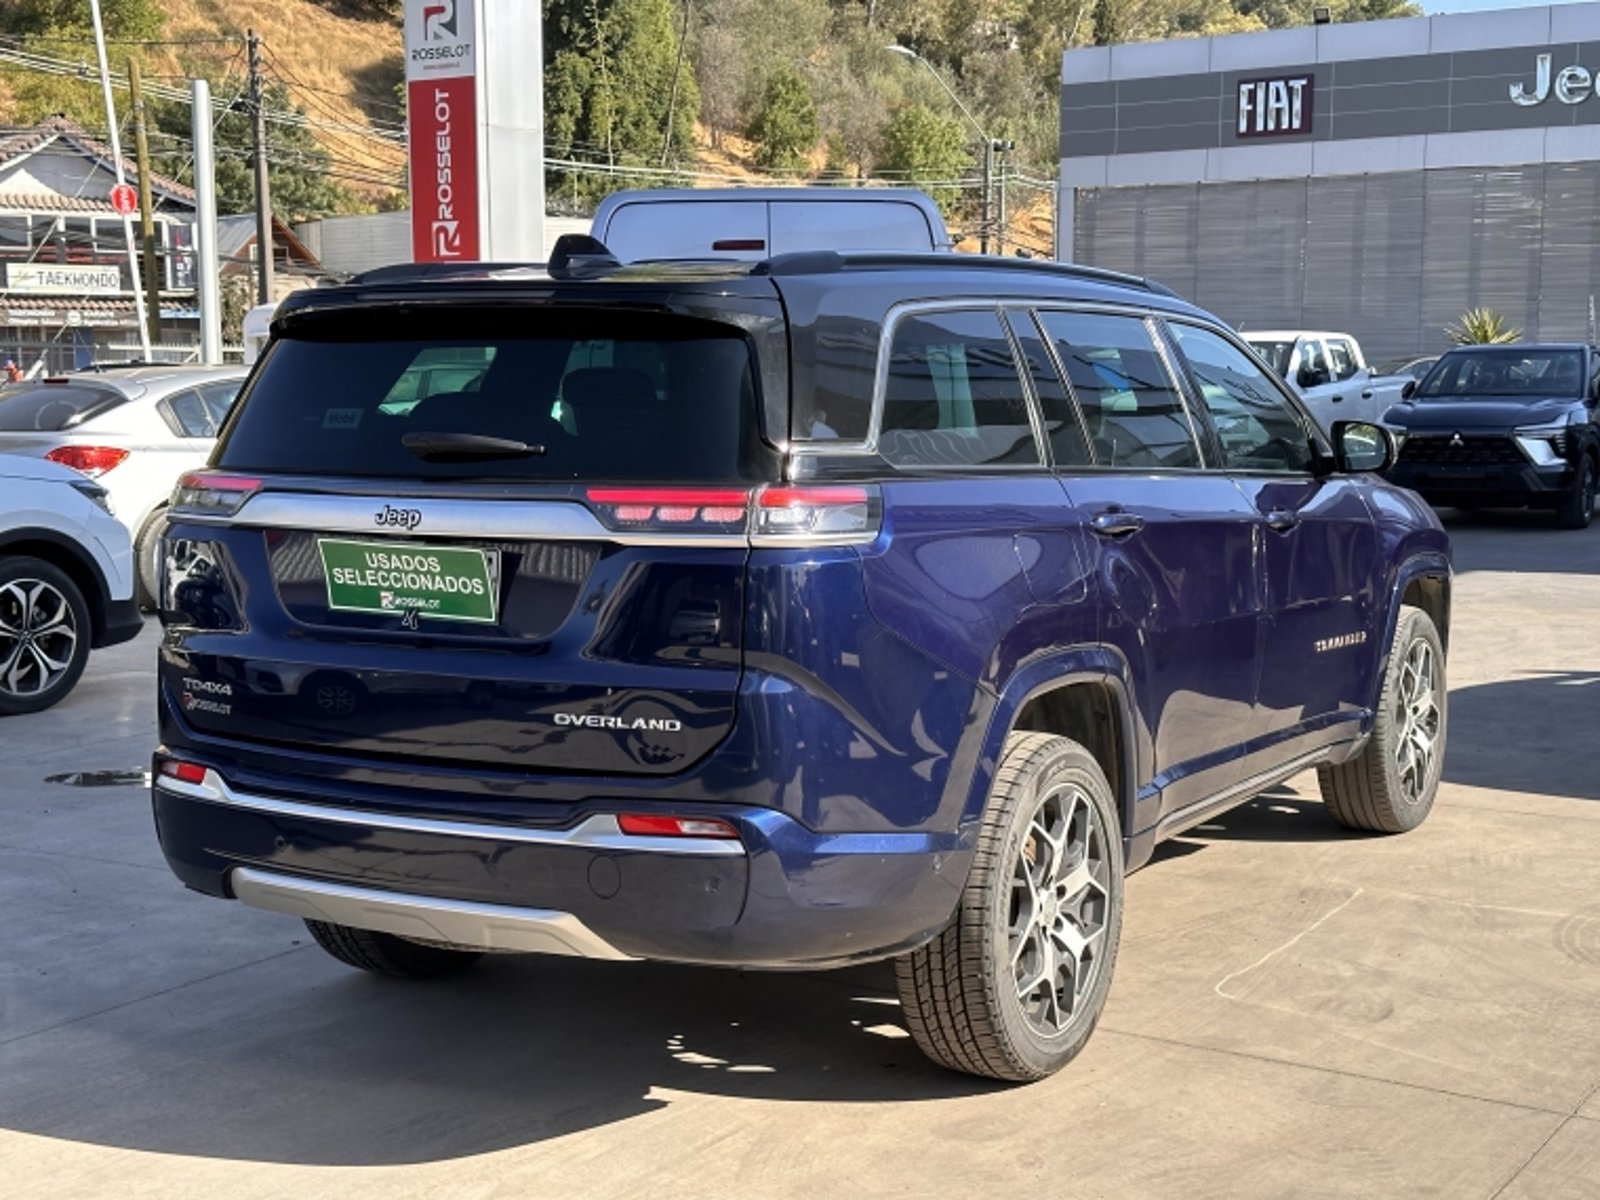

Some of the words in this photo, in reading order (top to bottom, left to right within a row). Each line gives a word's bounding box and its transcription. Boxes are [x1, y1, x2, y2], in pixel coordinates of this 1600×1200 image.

[412, 44, 471, 60] ROSSELOT
[1508, 53, 1600, 106] Je
[1238, 78, 1308, 133] FIAT
[435, 88, 453, 219] ROSSELOT
[37, 271, 119, 287] TAEKWONDO
[375, 505, 422, 530] Jeep
[365, 552, 441, 573] USADOS
[332, 567, 484, 595] SELECCIONADOS
[553, 713, 681, 731] OVERLAND
